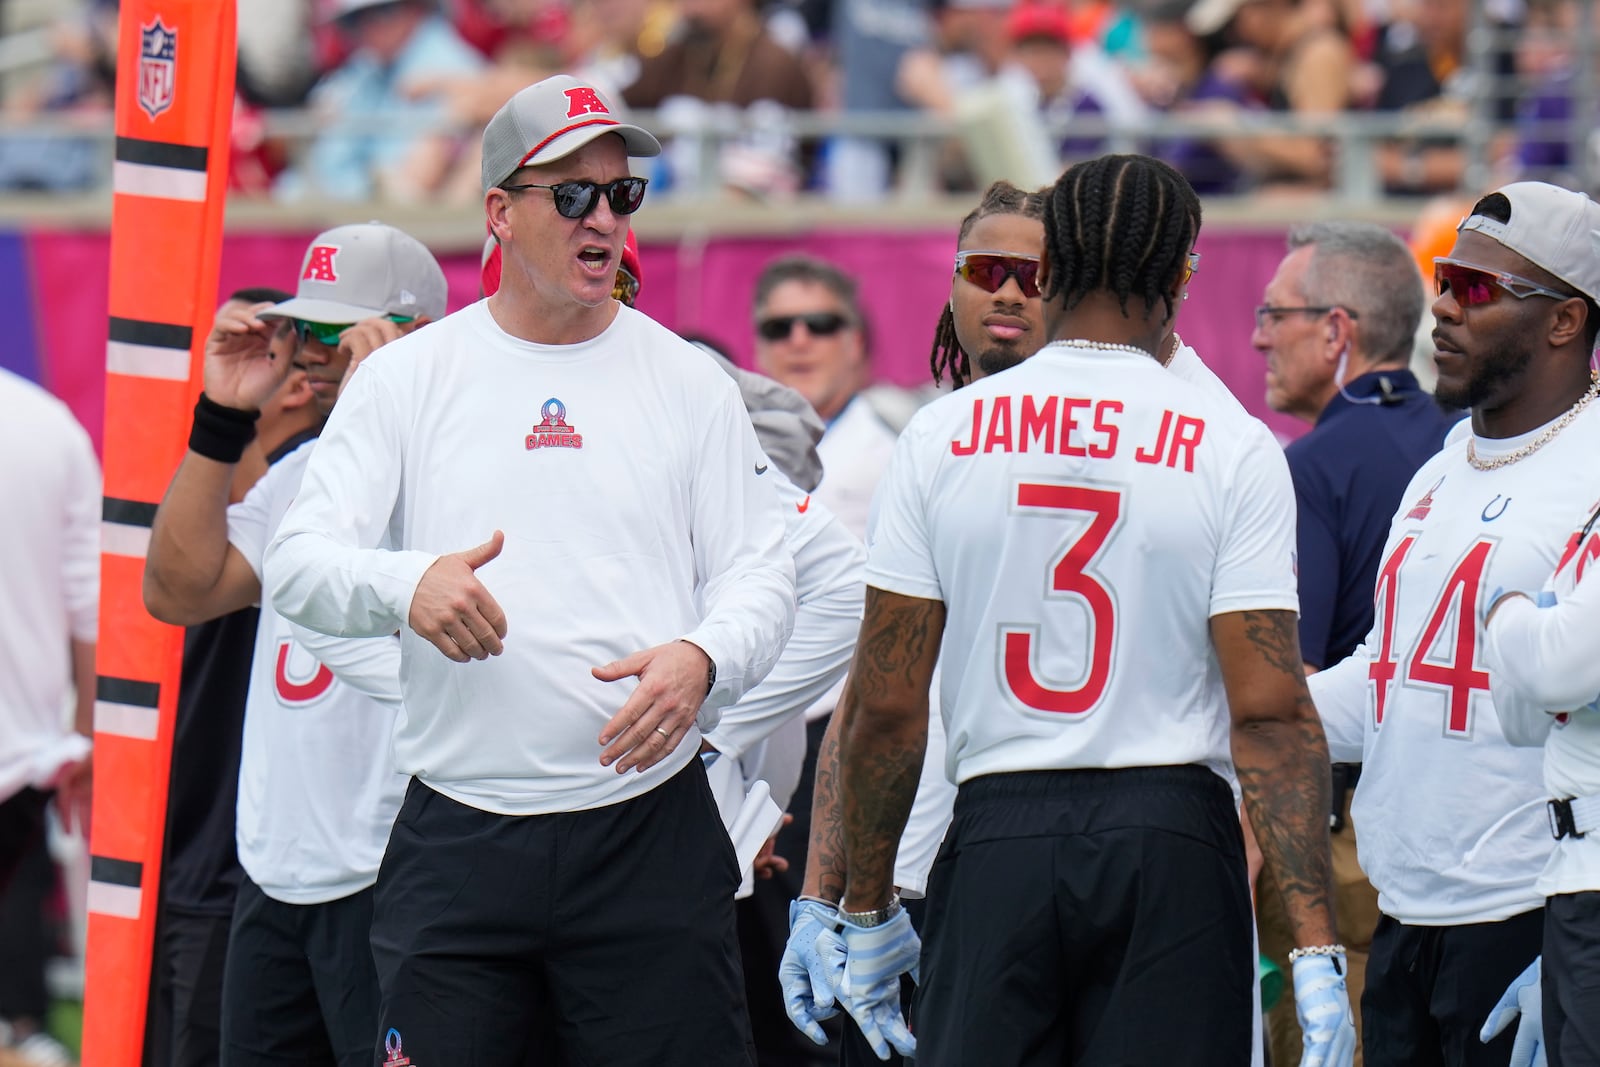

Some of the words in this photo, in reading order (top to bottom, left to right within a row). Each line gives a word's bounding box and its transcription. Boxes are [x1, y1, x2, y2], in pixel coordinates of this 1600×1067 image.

[141, 62, 174, 107] NFL
[563, 87, 609, 119] A
[304, 246, 338, 282] A
[525, 434, 583, 451] GAMES
[951, 395, 1124, 459] JAMES
[1136, 409, 1206, 473] JR
[1003, 482, 1121, 715] 3
[1368, 536, 1491, 732] 44
